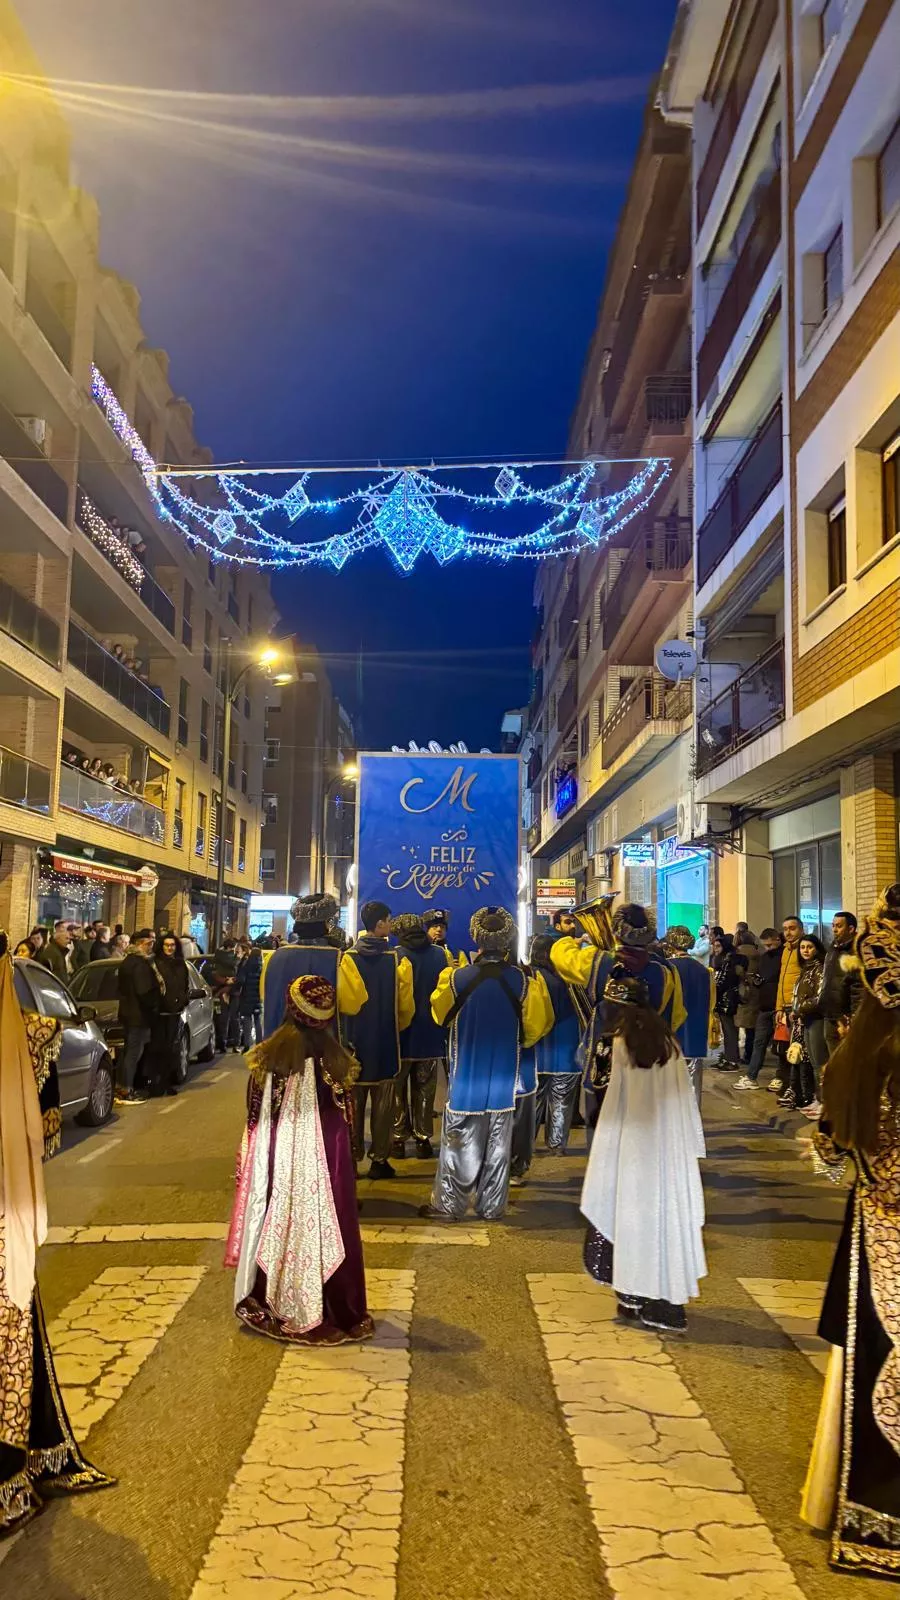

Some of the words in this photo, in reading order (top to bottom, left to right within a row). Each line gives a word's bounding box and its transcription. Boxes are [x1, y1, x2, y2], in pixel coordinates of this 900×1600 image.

[661, 649, 692, 658] Televés
[430, 846, 476, 863] FELIZ
[430, 863, 460, 873] noche
[463, 863, 476, 873] de
[387, 863, 468, 899] Reyes
